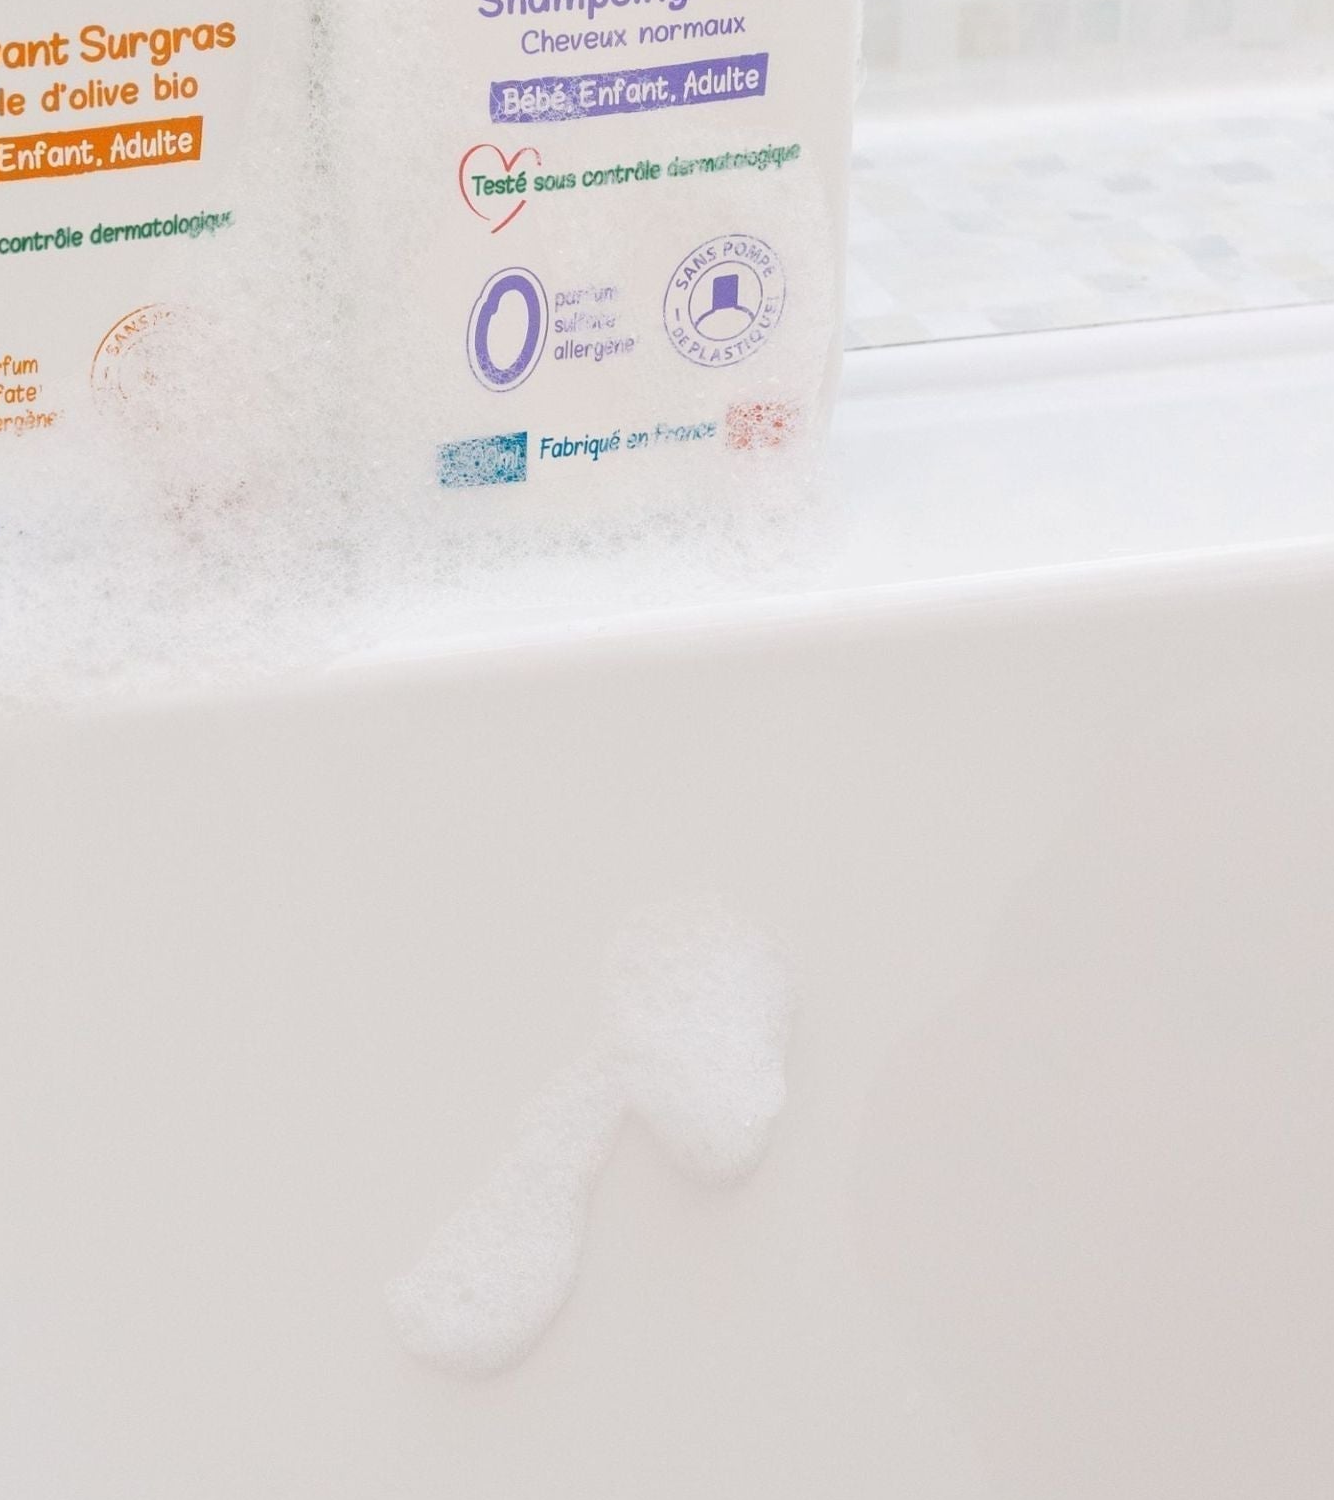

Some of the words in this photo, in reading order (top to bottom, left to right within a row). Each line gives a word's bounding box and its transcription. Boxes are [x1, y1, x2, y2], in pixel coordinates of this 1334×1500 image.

[79, 21, 237, 66] Surgras
[521, 28, 627, 55] Cheveux
[639, 16, 746, 44] normaux
[41, 80, 138, 113] d'olive
[154, 72, 198, 101] bio
[684, 66, 760, 97] Adulte
[110, 129, 193, 163] Adulte
[471, 172, 527, 196] Testé
[534, 172, 576, 193] sous
[582, 160, 661, 188] contrôle
[676, 246, 717, 290] SANS
[540, 428, 621, 462] Fabriqué
[626, 431, 649, 450] en
